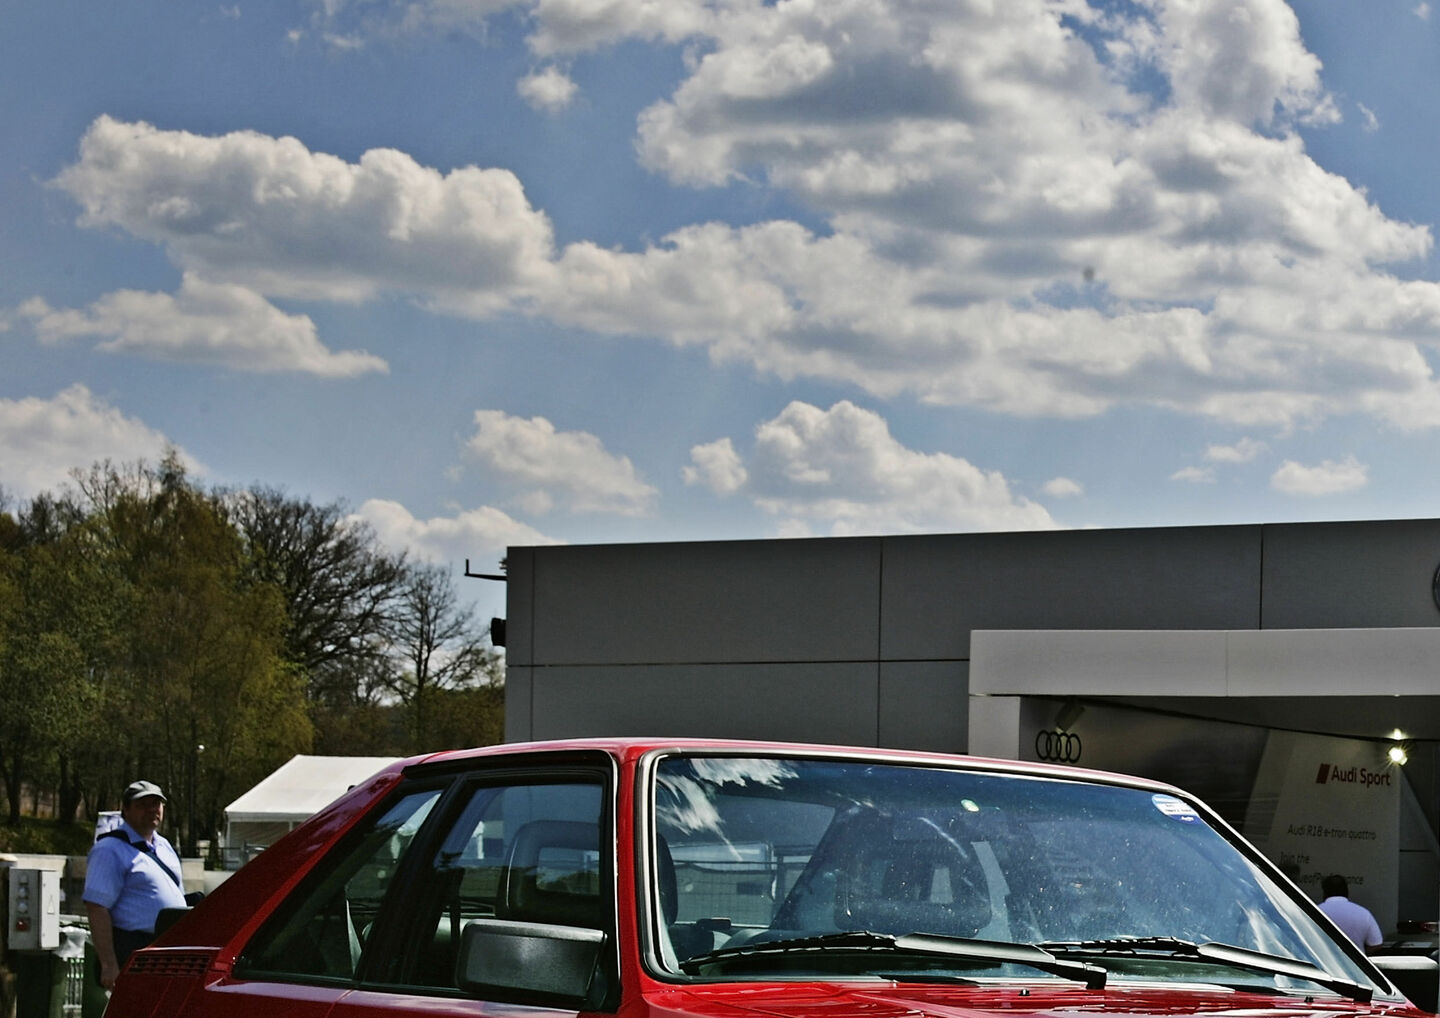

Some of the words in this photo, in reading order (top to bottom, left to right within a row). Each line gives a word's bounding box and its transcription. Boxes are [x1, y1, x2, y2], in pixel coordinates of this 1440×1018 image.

[1331, 764, 1357, 783] Audi
[1359, 768, 1391, 789] Sport
[1287, 823, 1306, 836] Audi
